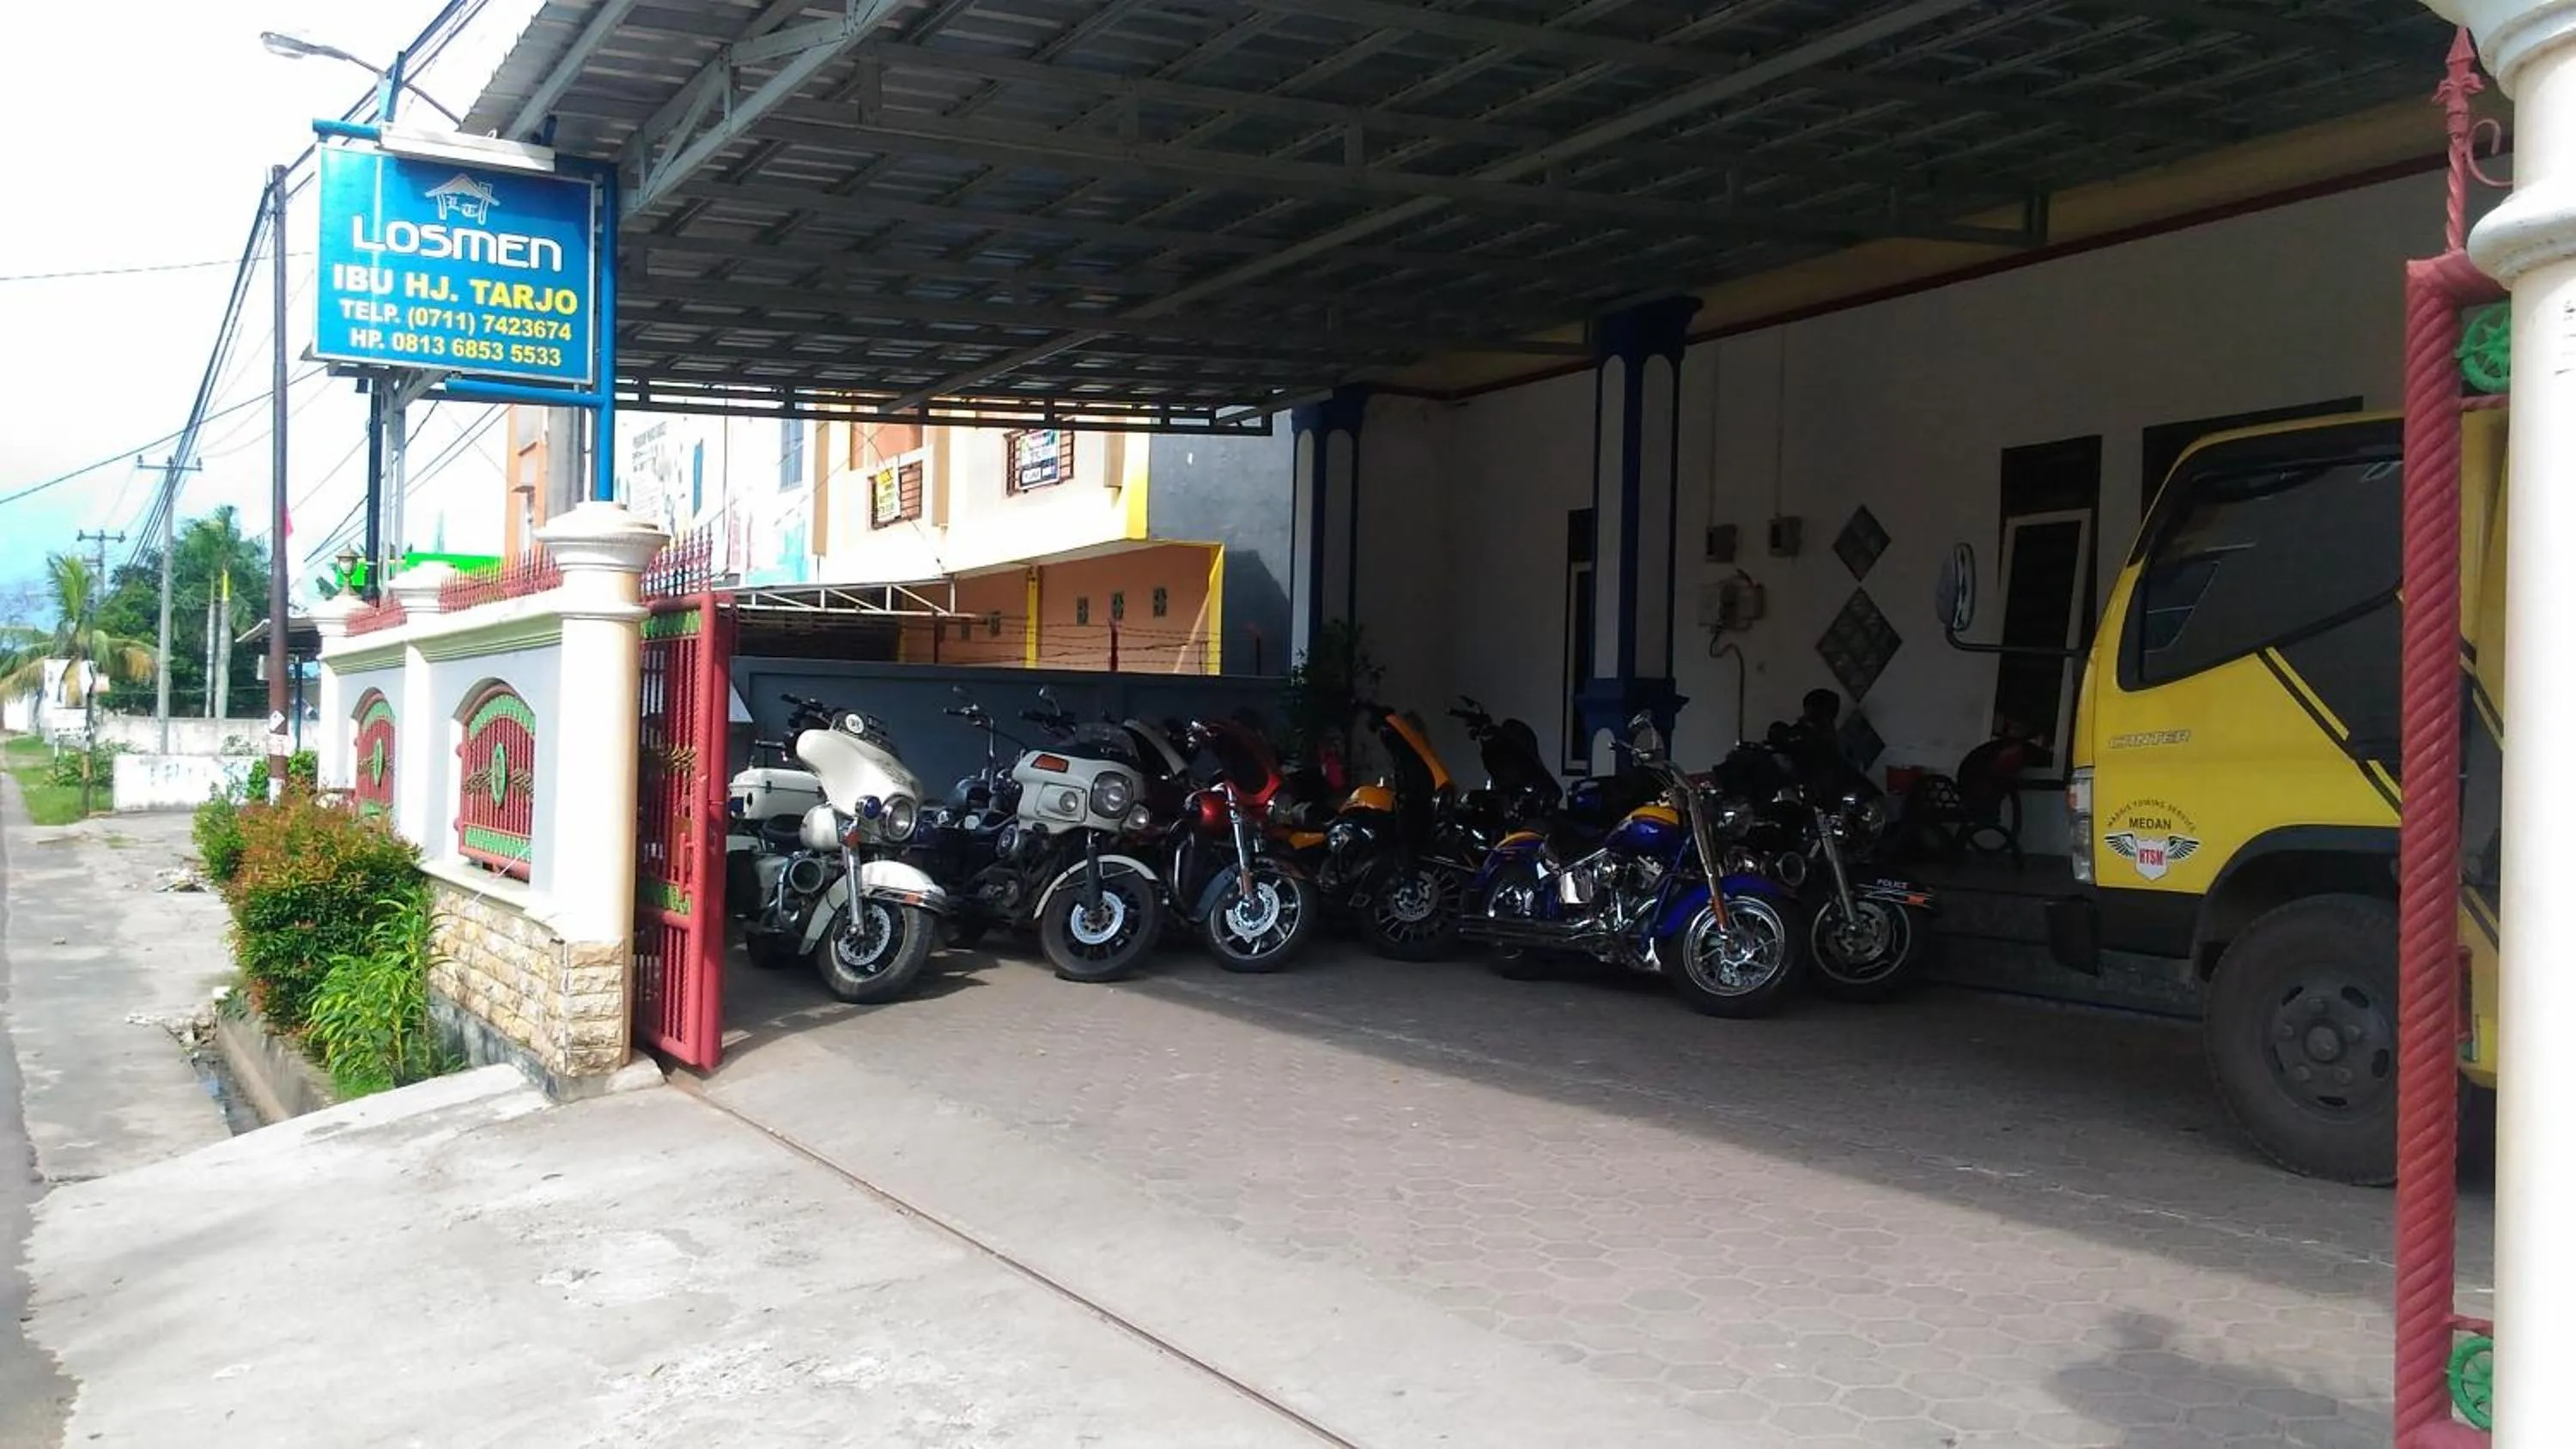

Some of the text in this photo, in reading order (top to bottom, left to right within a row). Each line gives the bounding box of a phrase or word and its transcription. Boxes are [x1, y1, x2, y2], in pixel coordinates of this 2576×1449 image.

[333, 264, 578, 315] IBU HJ. TARJO
[340, 300, 572, 341] TELP. (0711) 7423674
[350, 328, 562, 367] HP. 0813 6853 5533
[2129, 817, 2172, 830] MEDAN
[2139, 847, 2165, 866] HTSM
